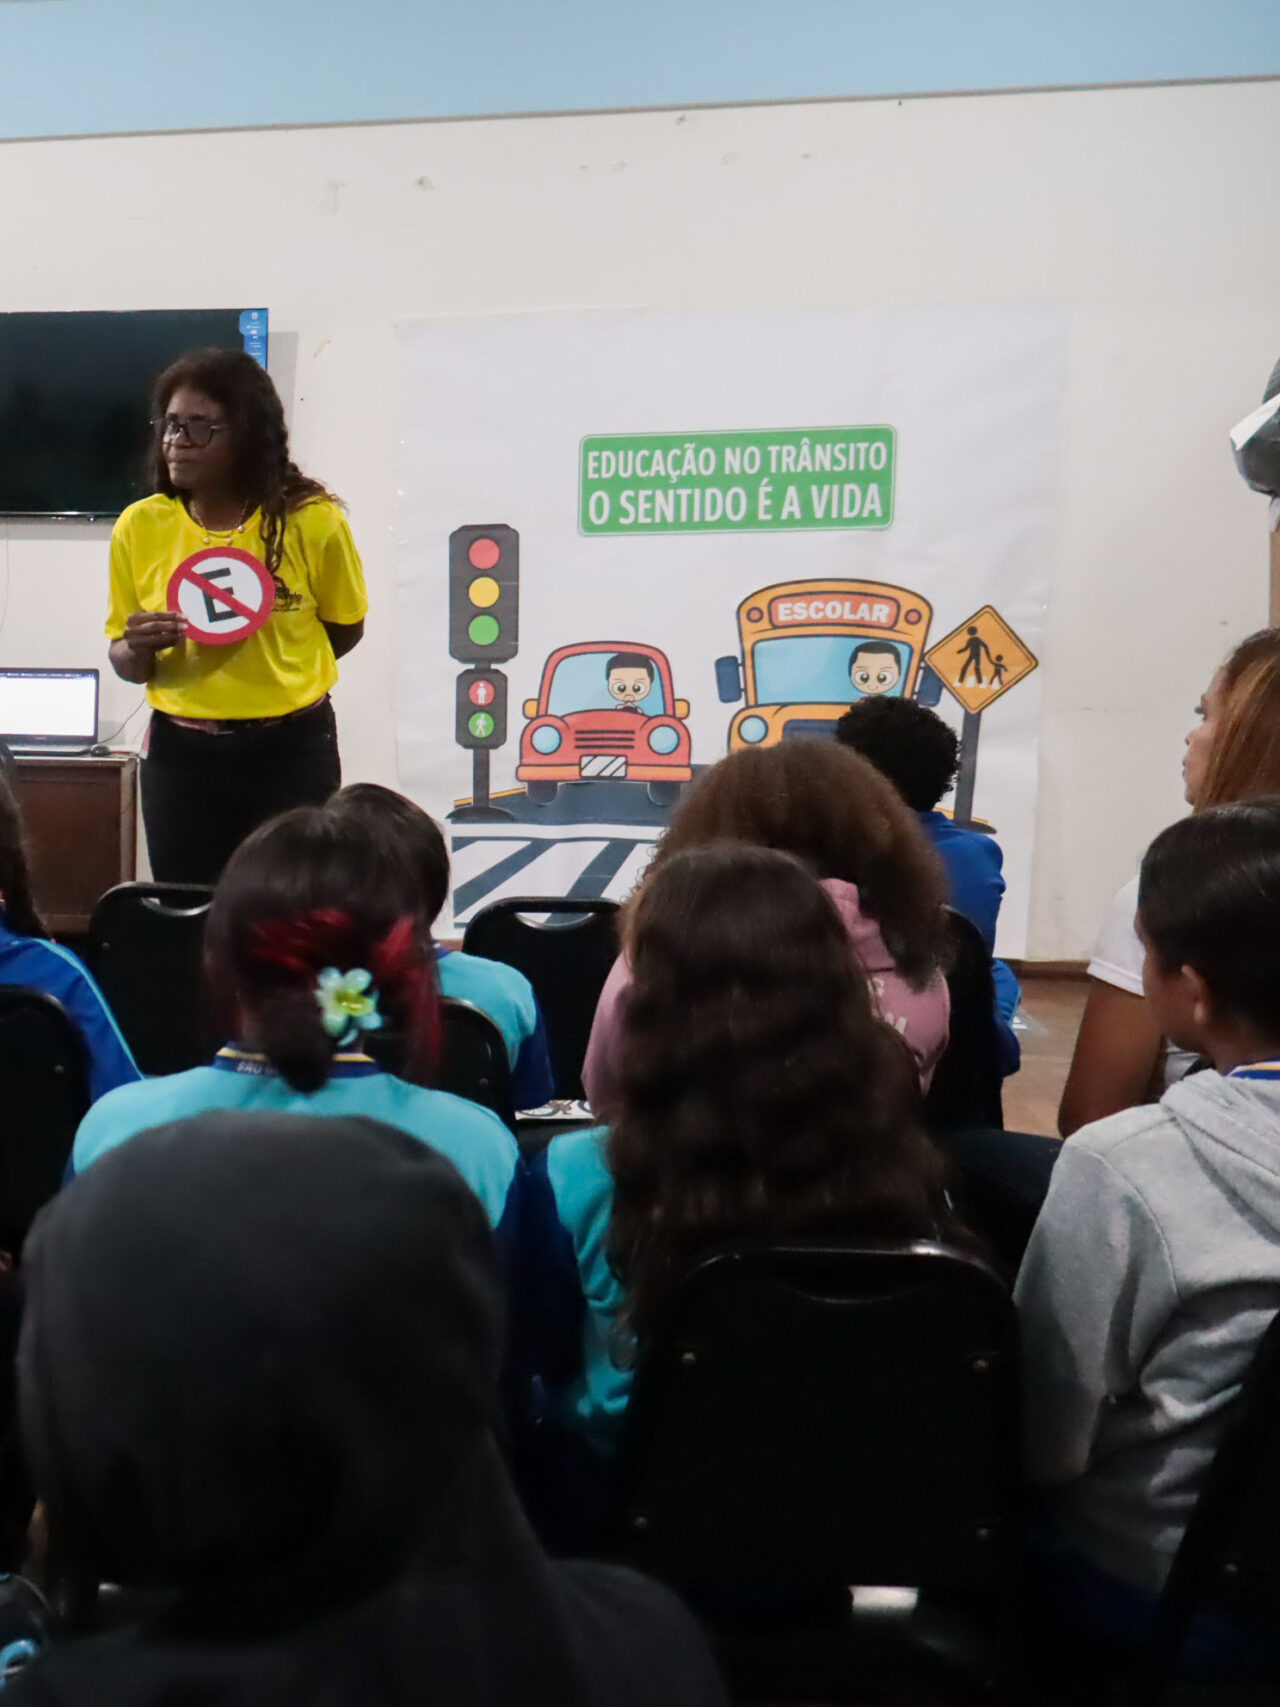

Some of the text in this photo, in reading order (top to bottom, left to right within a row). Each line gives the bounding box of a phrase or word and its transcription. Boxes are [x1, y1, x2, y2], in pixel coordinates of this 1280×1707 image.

[587, 437, 887, 483] EDUCAÇÃO NO TRÂNSITO
[588, 477, 883, 525] O SENTIDO É A VIDA
[199, 567, 243, 623] E
[777, 600, 890, 623] ESCOLAR
